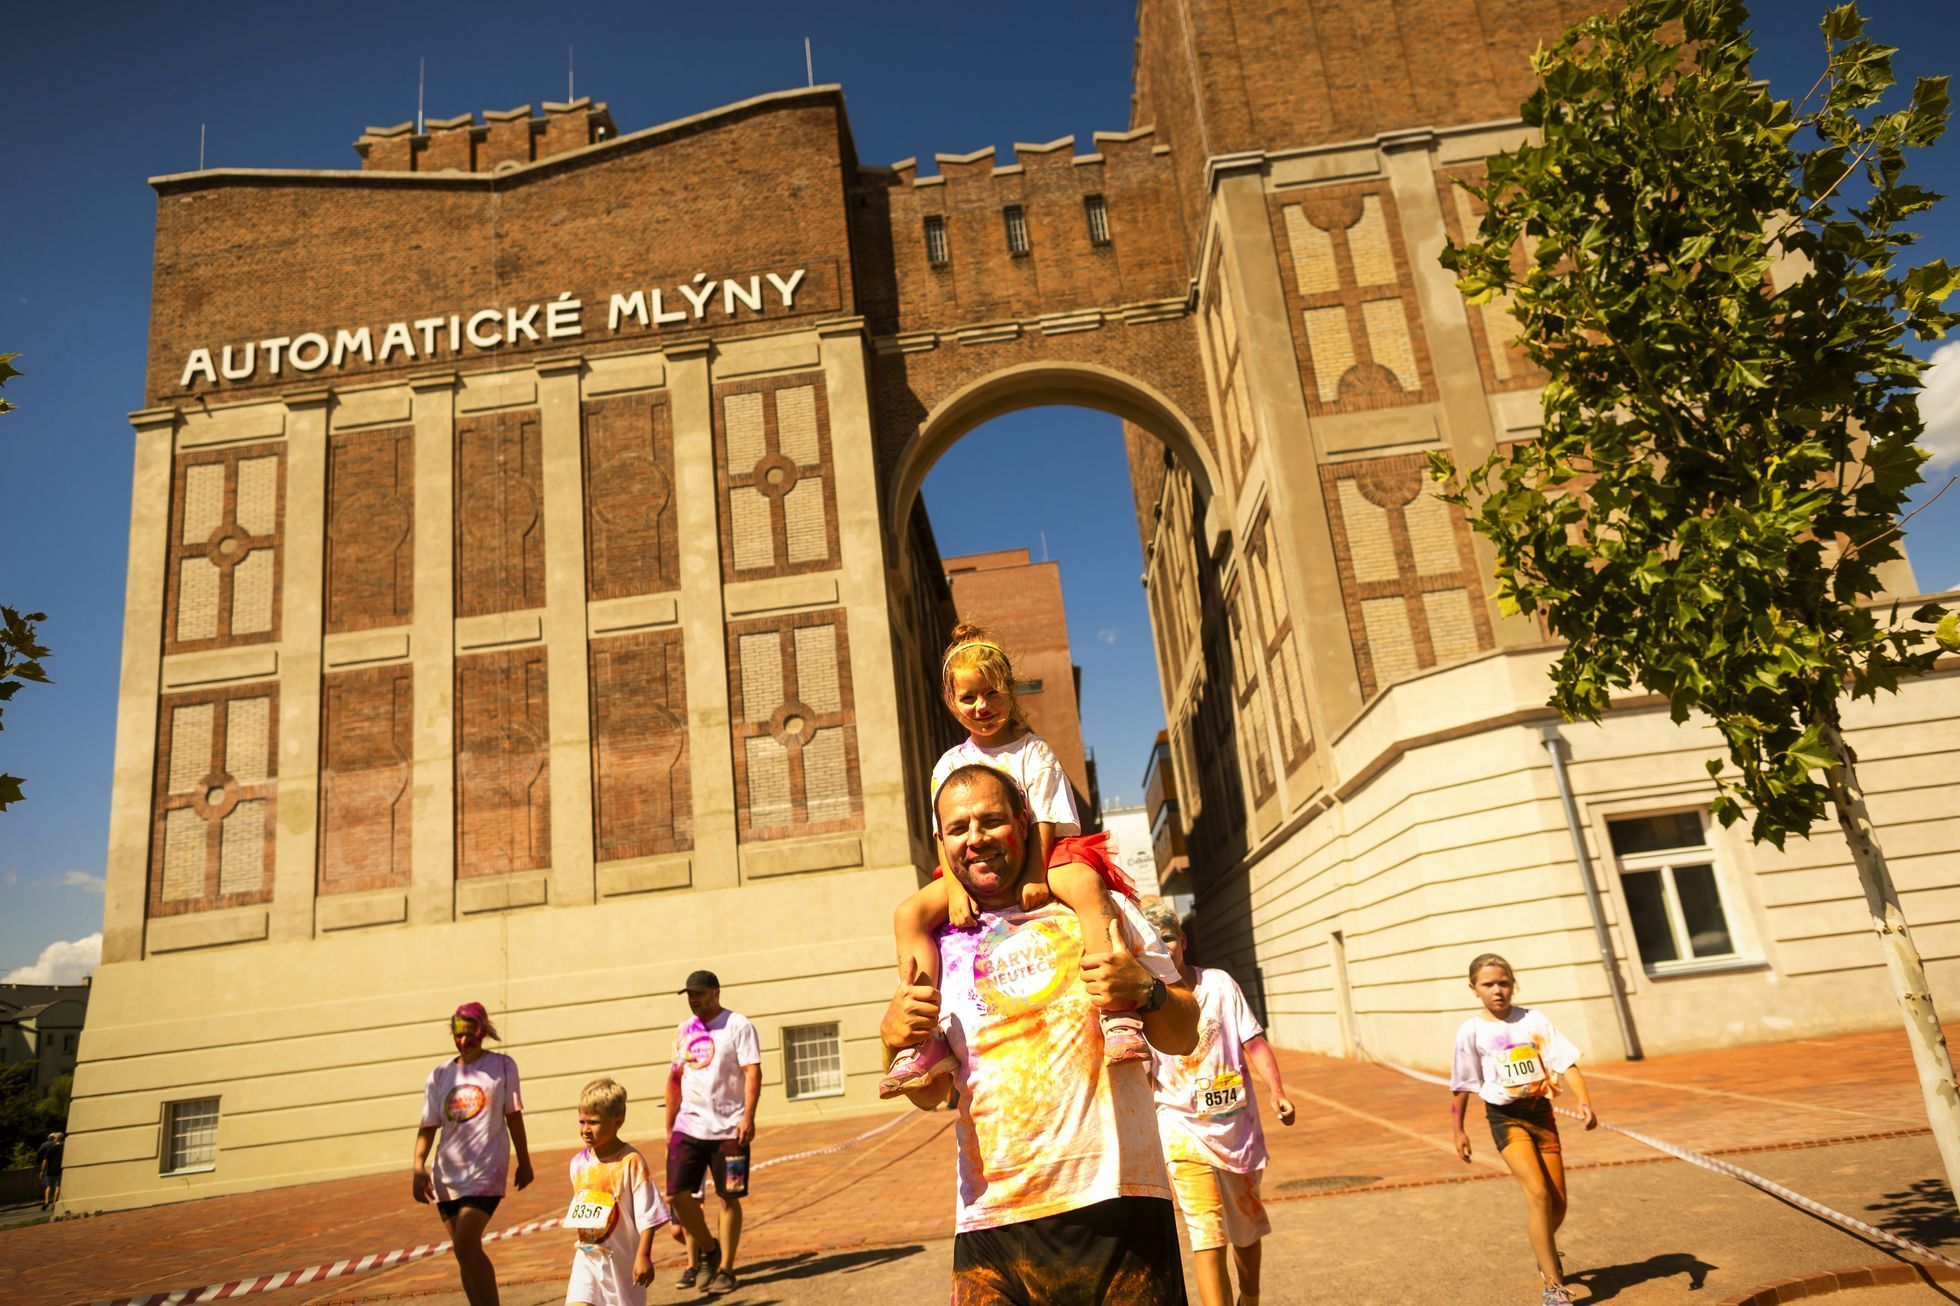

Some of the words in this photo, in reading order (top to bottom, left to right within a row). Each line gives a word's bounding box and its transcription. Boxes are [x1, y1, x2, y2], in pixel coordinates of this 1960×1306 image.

[179, 291, 582, 386] AUTOMATICKÉ
[608, 269, 806, 330] MLÝNY
[1503, 1060, 1535, 1078] 7100
[1204, 1087, 1237, 1107] 8574
[571, 1204, 603, 1219] 8356
